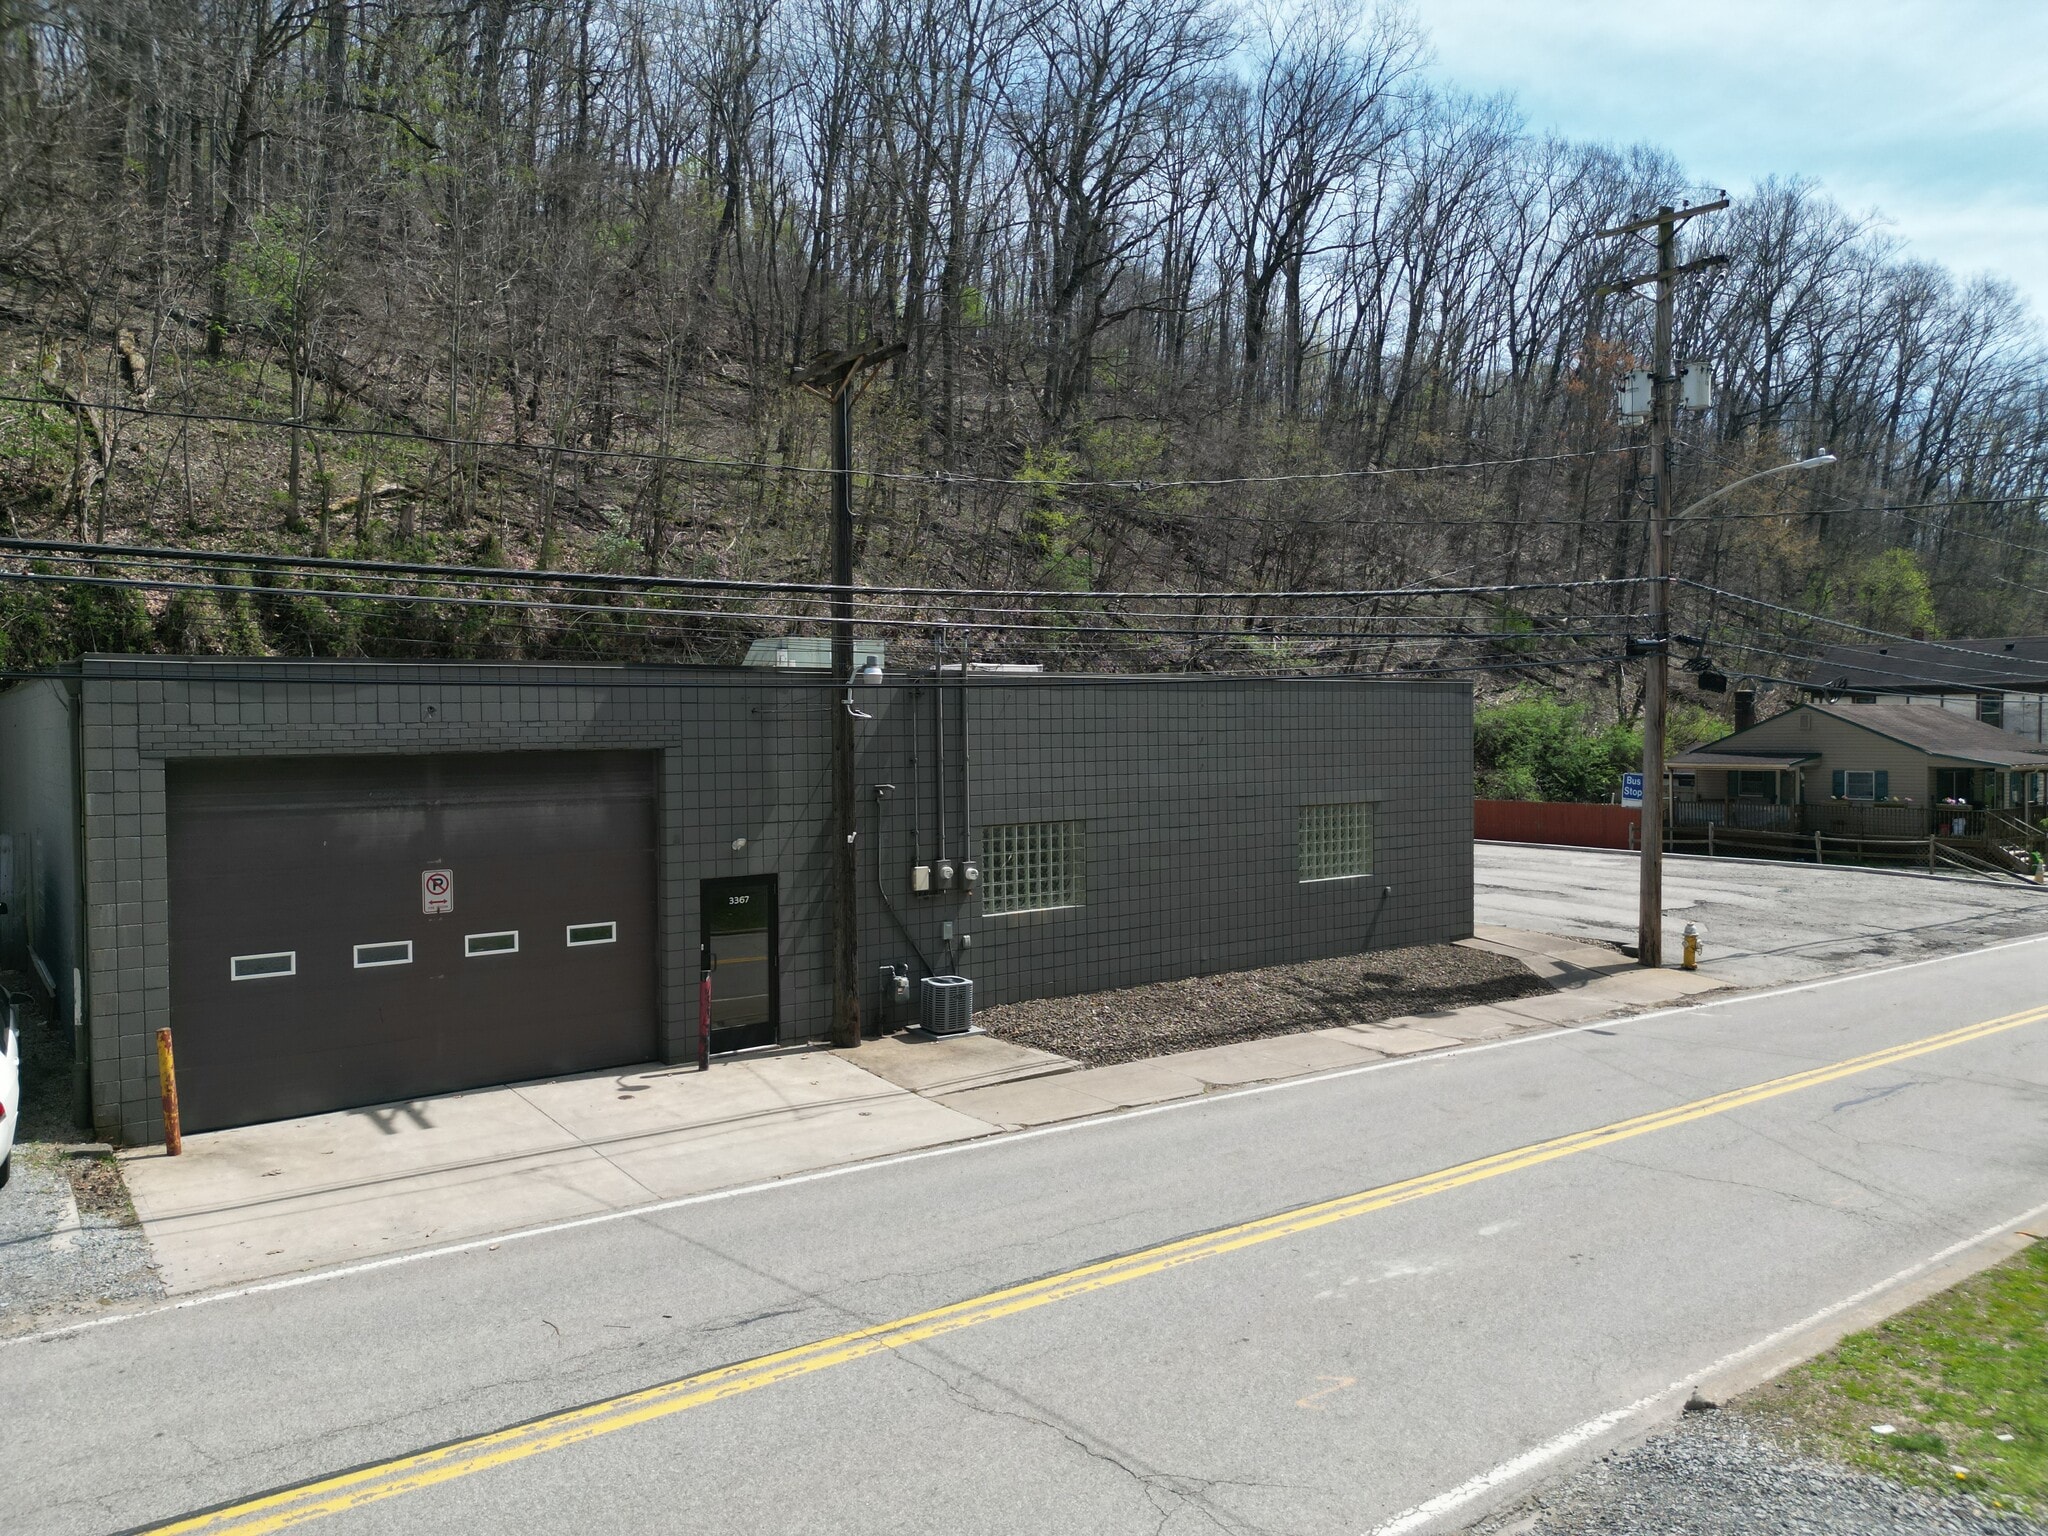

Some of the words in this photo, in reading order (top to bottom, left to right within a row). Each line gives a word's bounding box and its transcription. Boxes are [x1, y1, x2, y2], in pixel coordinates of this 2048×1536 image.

[1626, 776, 1641, 785] Bus
[1624, 787, 1642, 797] Stop
[432, 878, 443, 891] P
[729, 896, 749, 904] 3367
